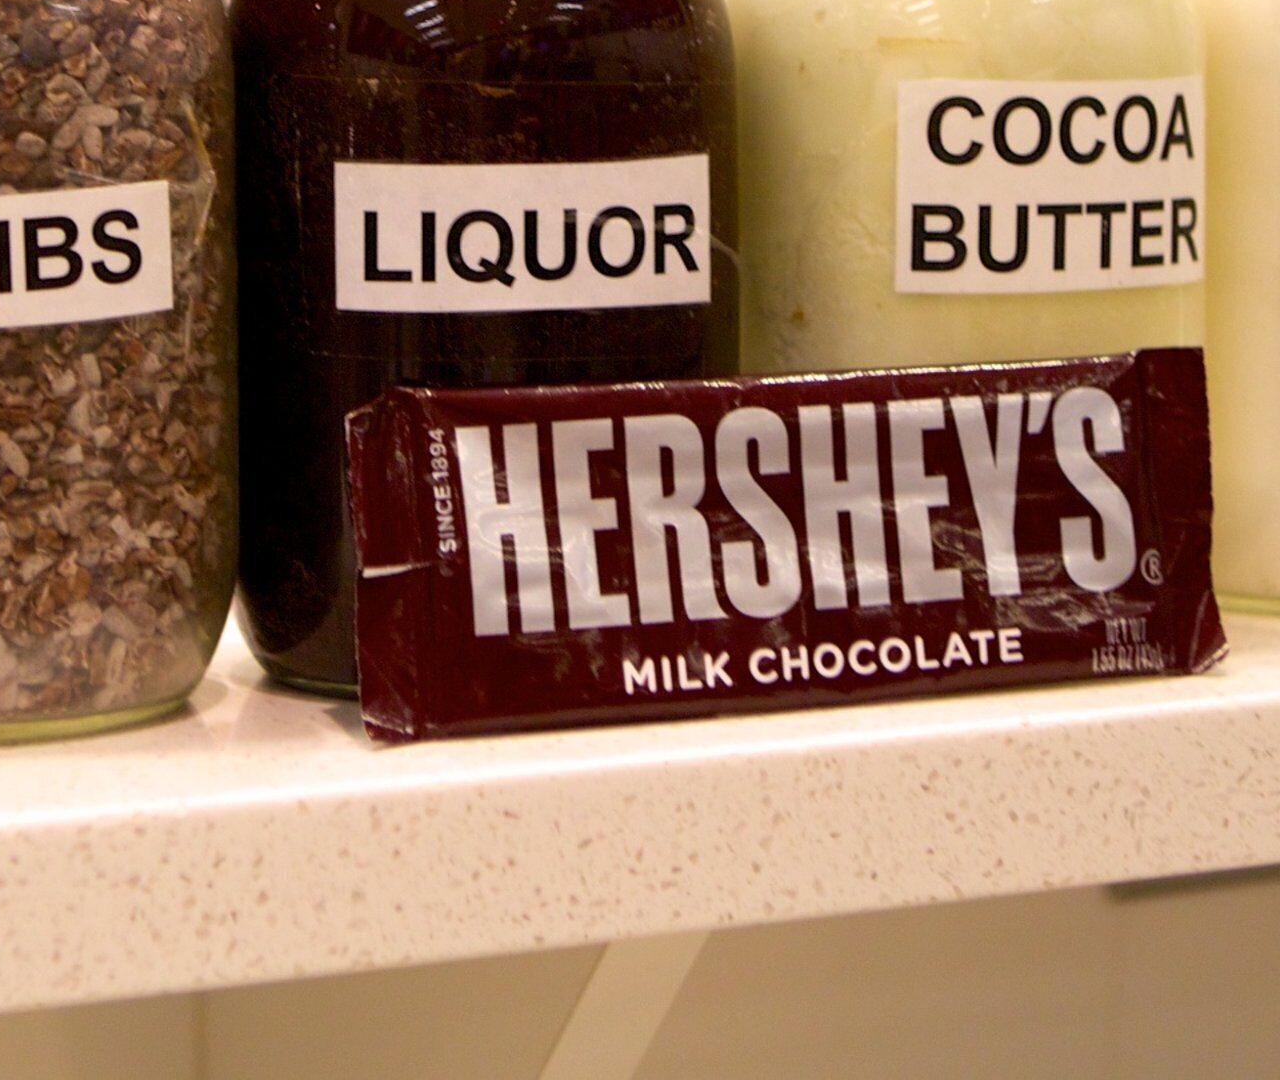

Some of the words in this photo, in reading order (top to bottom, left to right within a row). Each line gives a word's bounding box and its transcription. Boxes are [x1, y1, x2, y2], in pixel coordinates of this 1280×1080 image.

[926, 94, 1195, 165] COCOA
[362, 203, 700, 287] LIQUOR
[910, 196, 1199, 273] BUTTER
[428, 427, 450, 483] 1894
[433, 485, 457, 554] SINCE
[455, 386, 1136, 638] HERSHEY'S
[622, 652, 733, 695] MILK
[748, 627, 1024, 680] CHOCOLATE
